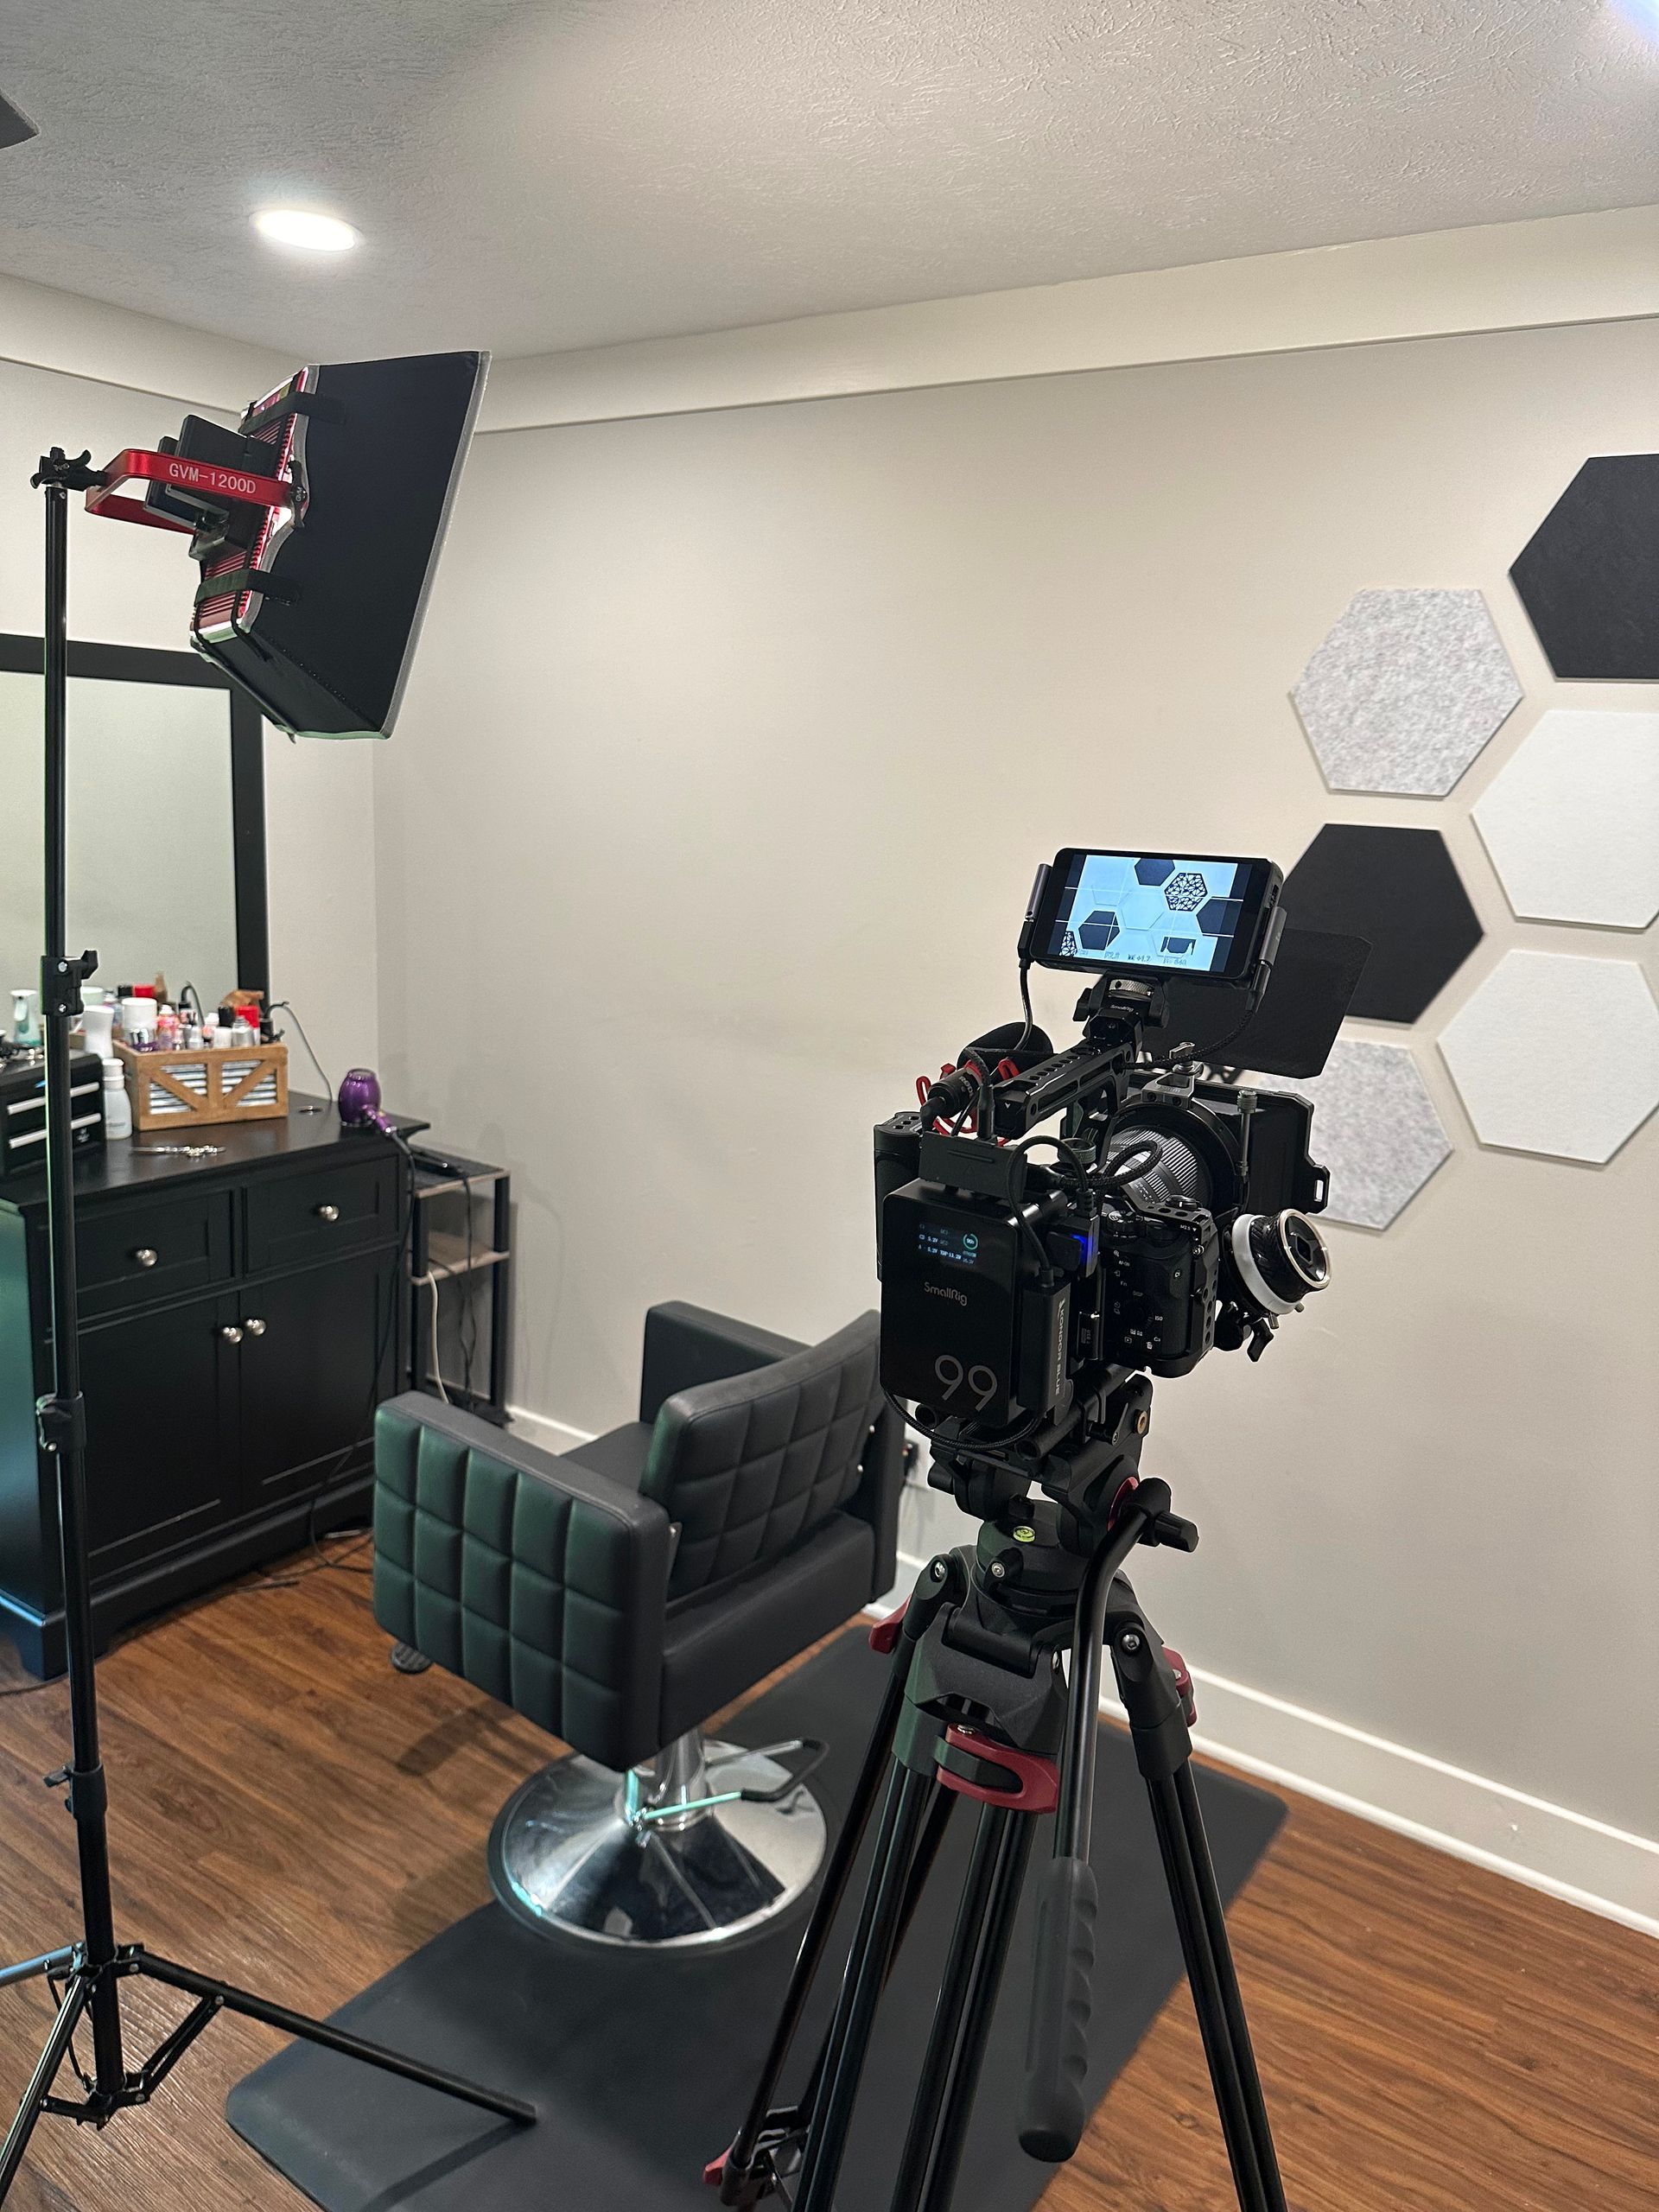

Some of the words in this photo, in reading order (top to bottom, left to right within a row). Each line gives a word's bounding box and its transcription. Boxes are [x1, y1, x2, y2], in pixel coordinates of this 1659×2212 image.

[168, 463, 257, 493] GVM-1200D
[924, 1281, 968, 1306] SmallRig
[935, 1354, 998, 1413] 99
